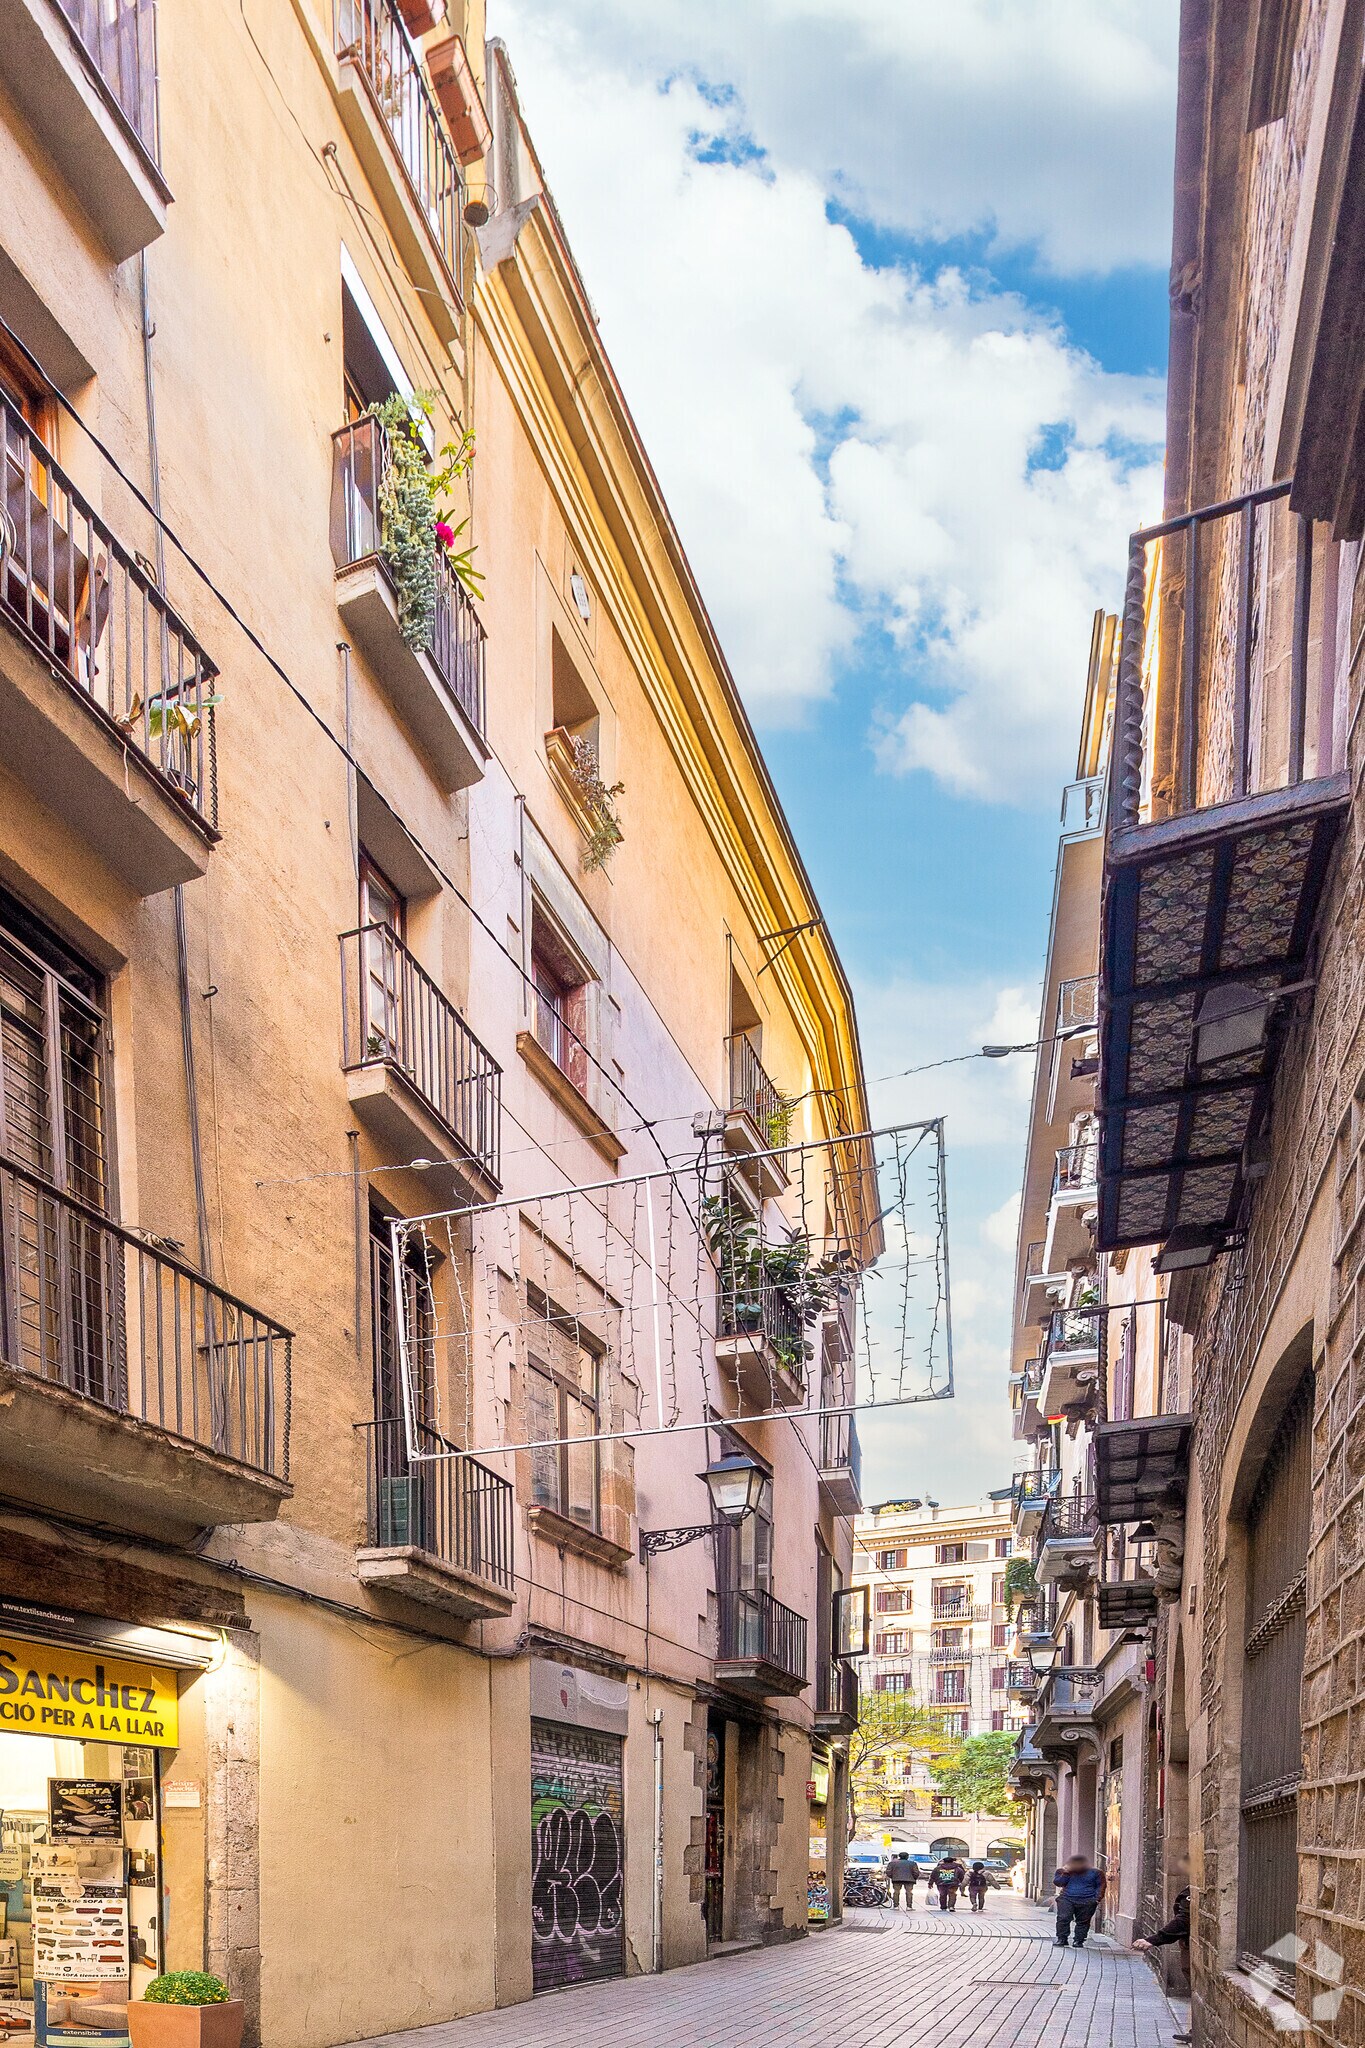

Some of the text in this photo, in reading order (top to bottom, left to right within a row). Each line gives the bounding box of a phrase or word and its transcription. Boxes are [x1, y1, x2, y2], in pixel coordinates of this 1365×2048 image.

[2, 1603, 75, 1623] www.textilsanchez.com
[42, 1706, 75, 1726] PER
[82, 1712, 95, 1729] A
[100, 1714, 121, 1732] LA
[126, 1718, 164, 1737] LLAR
[58, 1787, 112, 1795] OFERTA
